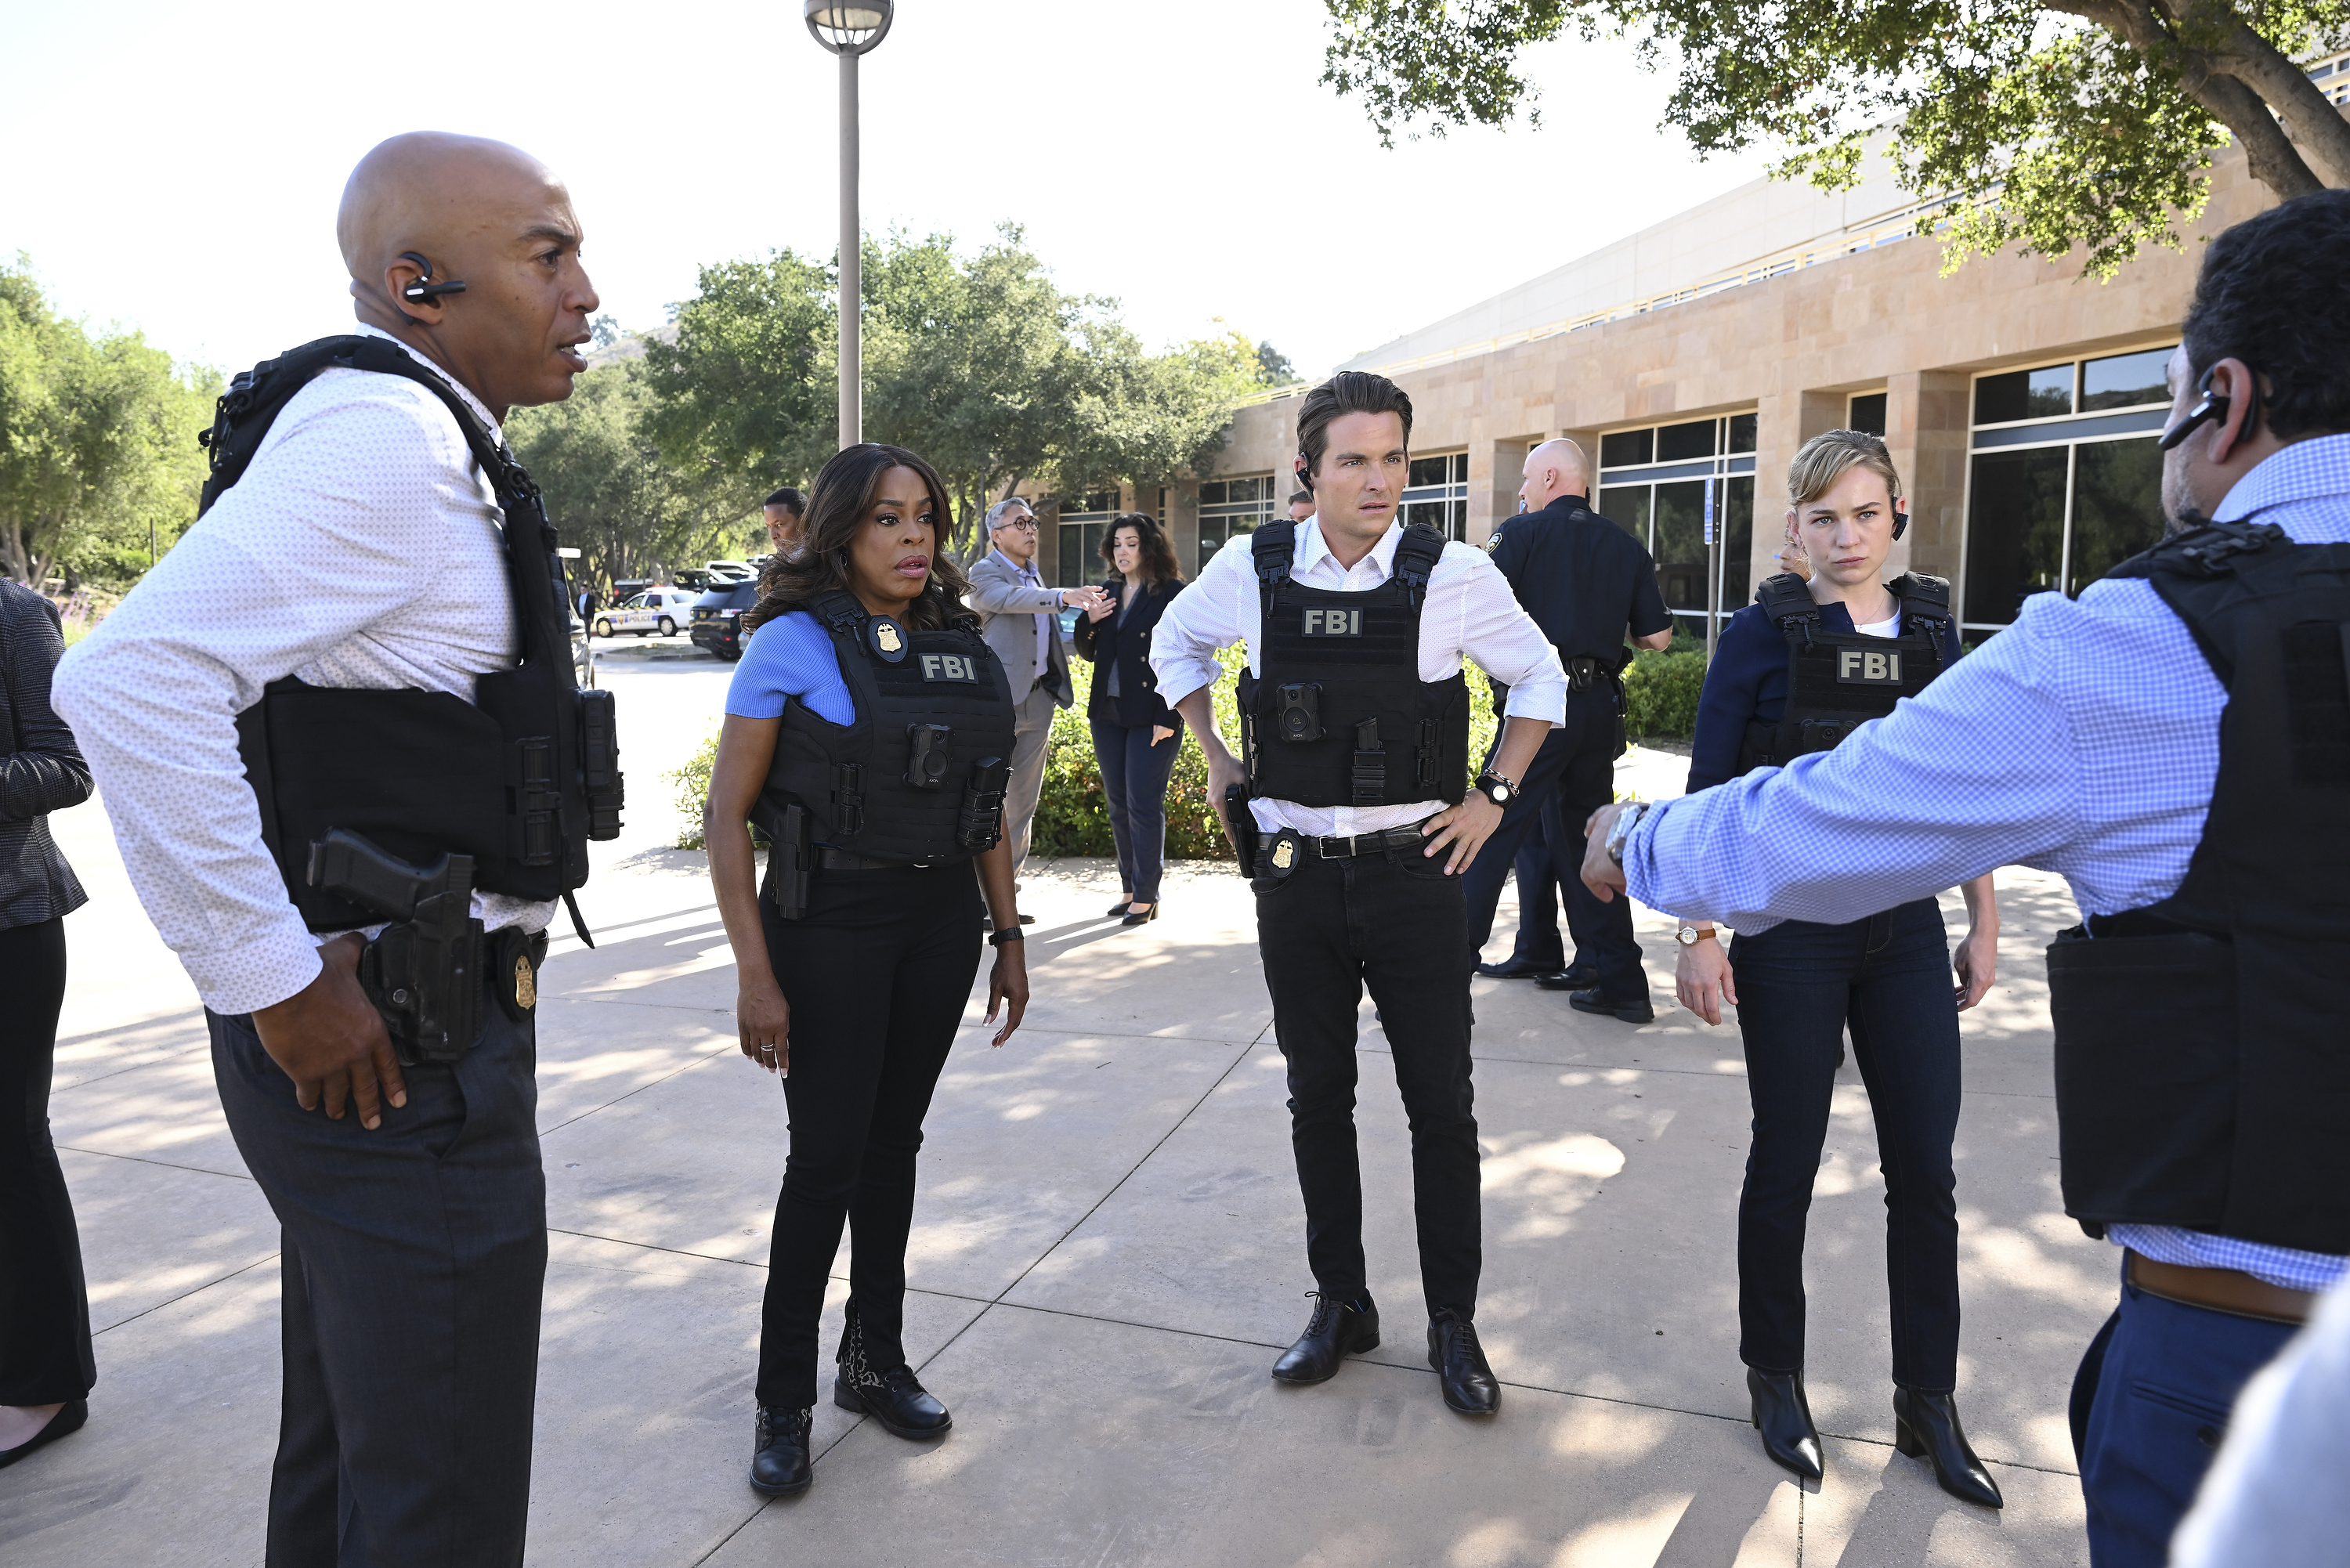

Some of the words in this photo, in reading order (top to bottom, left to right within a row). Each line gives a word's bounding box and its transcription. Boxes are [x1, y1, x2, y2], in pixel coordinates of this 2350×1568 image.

[629, 614, 650, 623] POLICE
[1305, 610, 1359, 634] FBI
[921, 656, 975, 681] FBI
[1841, 651, 1899, 681] FBI
